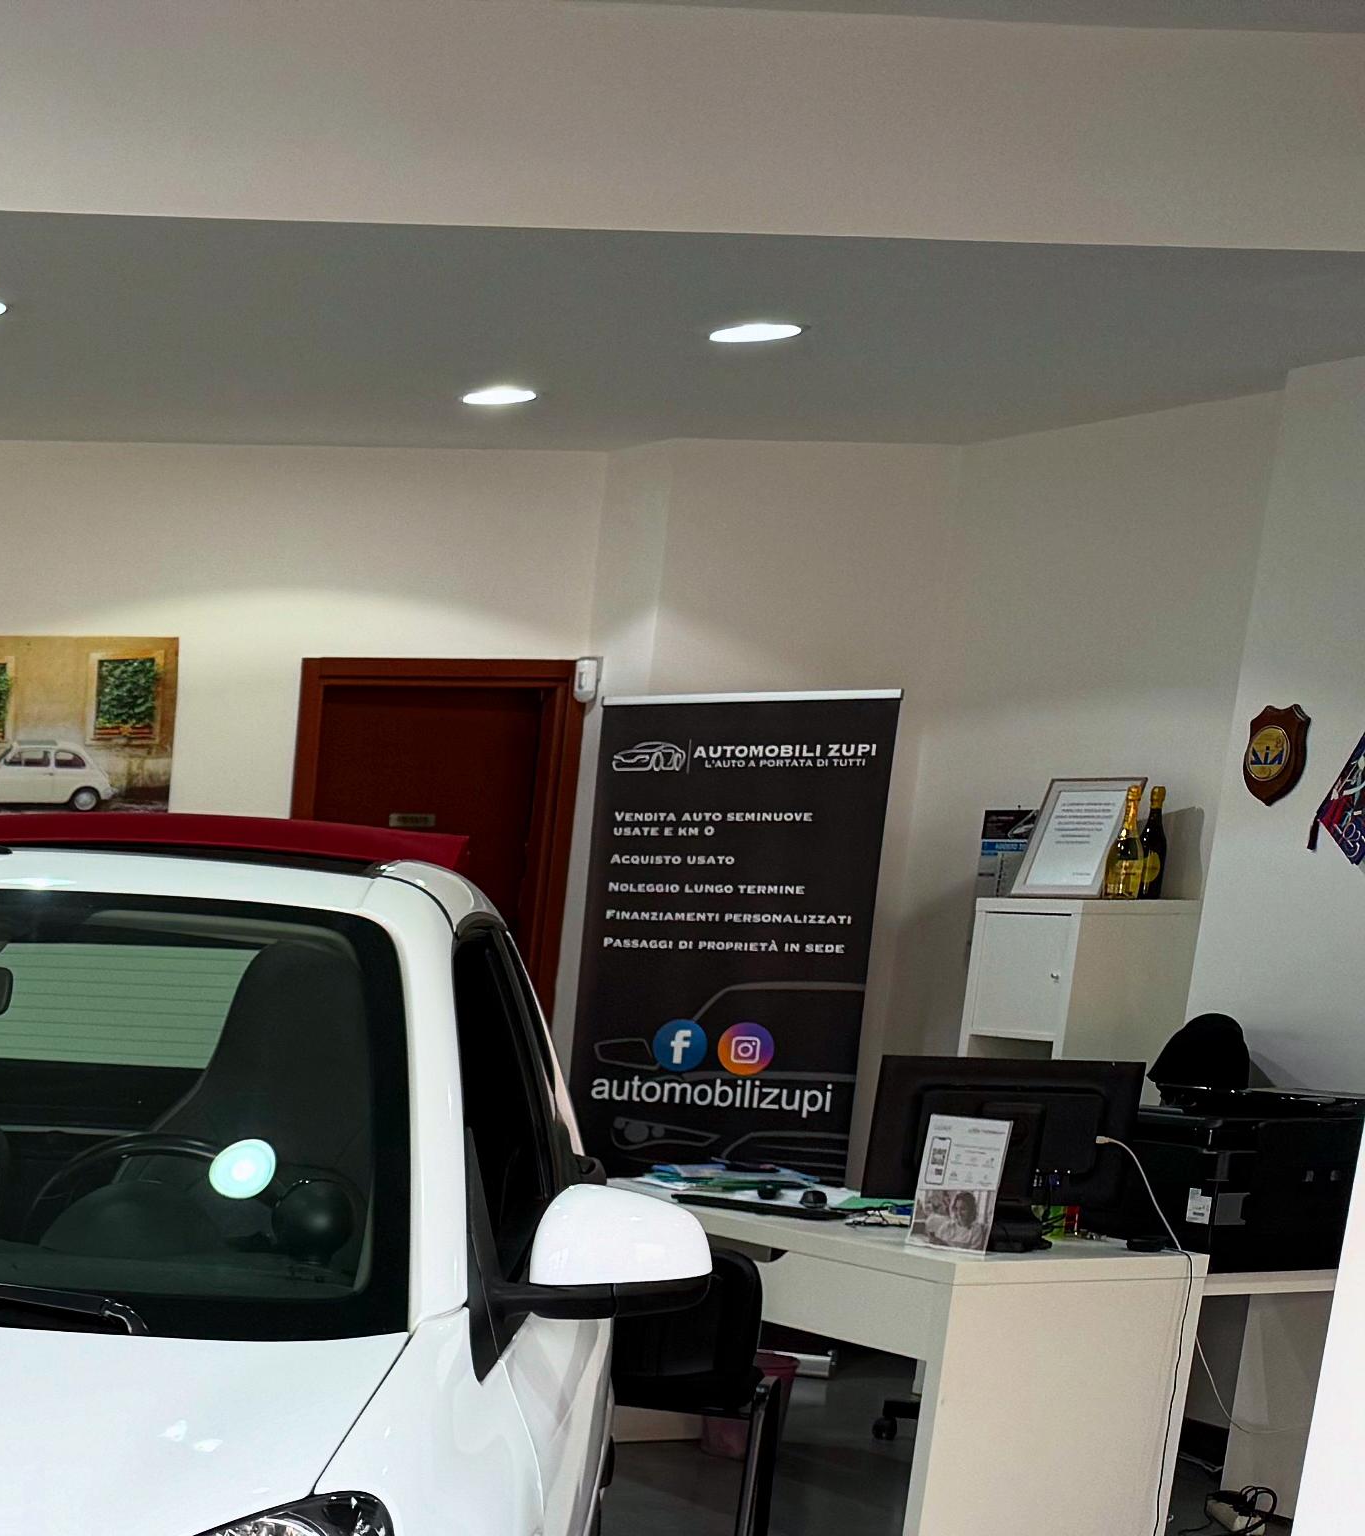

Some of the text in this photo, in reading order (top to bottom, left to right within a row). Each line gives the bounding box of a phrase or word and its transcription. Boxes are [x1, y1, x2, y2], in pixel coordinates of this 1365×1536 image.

[693, 743, 877, 759] AUTOMOBILI ZUPI
[704, 758, 866, 769] L'AUTO A PORTATA DI TUTTI
[615, 811, 814, 822] VENDITA AUTO SEMINUOVE
[613, 826, 660, 836] USATE
[663, 827, 673, 836] E
[678, 827, 699, 836] KM
[610, 854, 735, 865] ACQUISTO USATO
[608, 881, 805, 895] NOLEGGIO LUNGO TERMINE
[605, 909, 852, 925] FINANZIAMENTI PERSONALIZZATI
[603, 937, 845, 954] PASSAGGI DI PROPRIETÀ IN SEDE
[590, 1075, 833, 1118] automobilizupi
